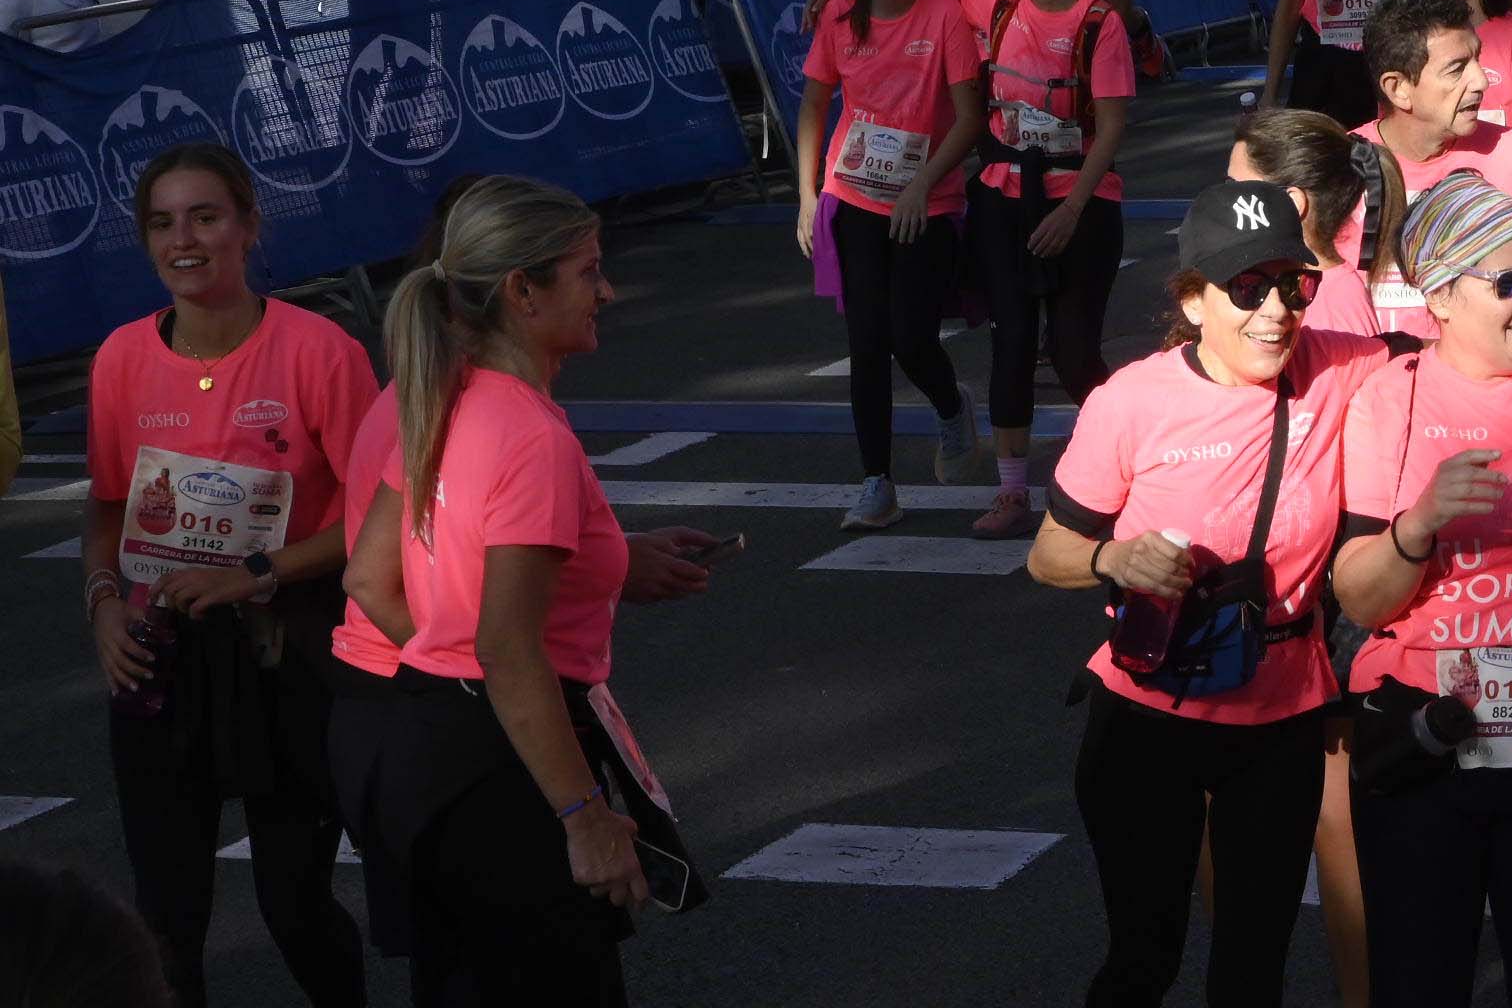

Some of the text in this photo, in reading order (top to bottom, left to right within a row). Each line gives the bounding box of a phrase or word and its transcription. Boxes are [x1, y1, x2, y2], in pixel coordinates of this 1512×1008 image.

[565, 49, 650, 94] ASTURIANA
[470, 65, 562, 113] ASTURIANA
[1021, 130, 1050, 142] 016
[865, 156, 894, 172] 016
[1377, 286, 1420, 299] OYSHO
[138, 412, 190, 429] OYSHO
[234, 408, 286, 422] ASTURIANA
[1162, 442, 1232, 465] OYSHO
[182, 479, 240, 502] ASTURIANA
[180, 512, 233, 535] 016
[182, 536, 225, 551] 31142
[139, 544, 183, 561] CARRERA
[184, 551, 198, 561] DE
[212, 556, 244, 566] MUJER
[1490, 725, 1505, 734] DE
